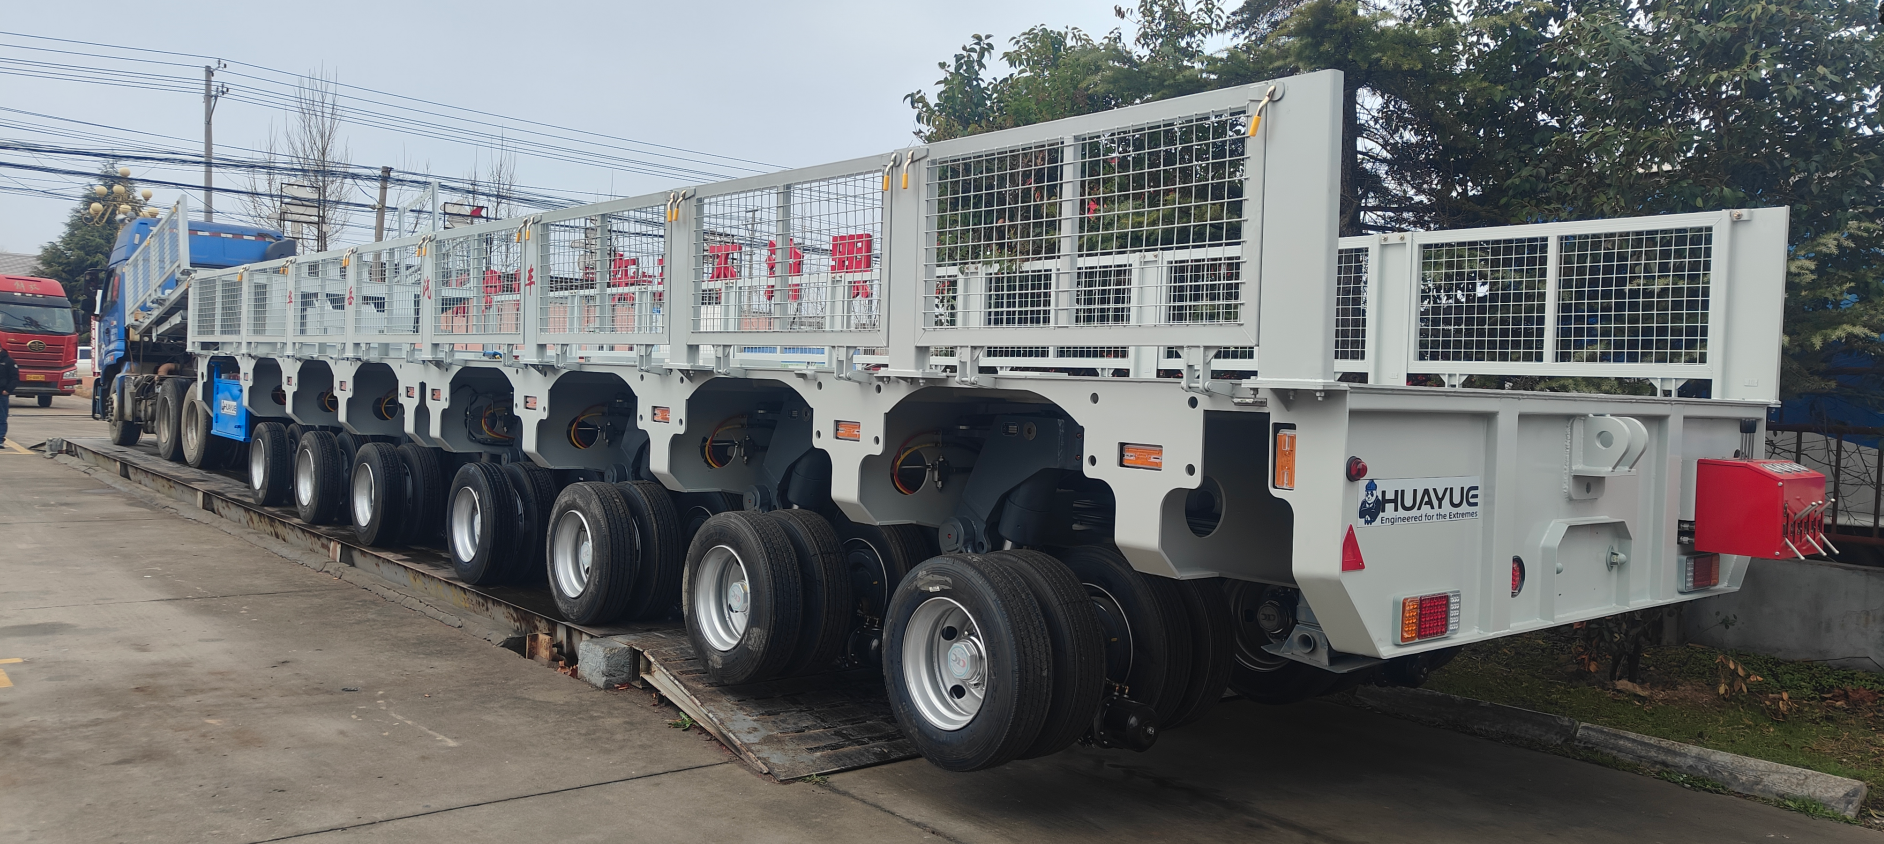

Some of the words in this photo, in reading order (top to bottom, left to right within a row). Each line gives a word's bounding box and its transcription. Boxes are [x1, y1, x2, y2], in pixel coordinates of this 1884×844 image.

[525, 264, 535, 296] 车
[1381, 486, 1479, 513] HUAYUE
[1381, 513, 1422, 525] Engineered
[1424, 512, 1434, 521] for
[1435, 512, 1447, 520] the
[1448, 510, 1478, 519] Extremes
